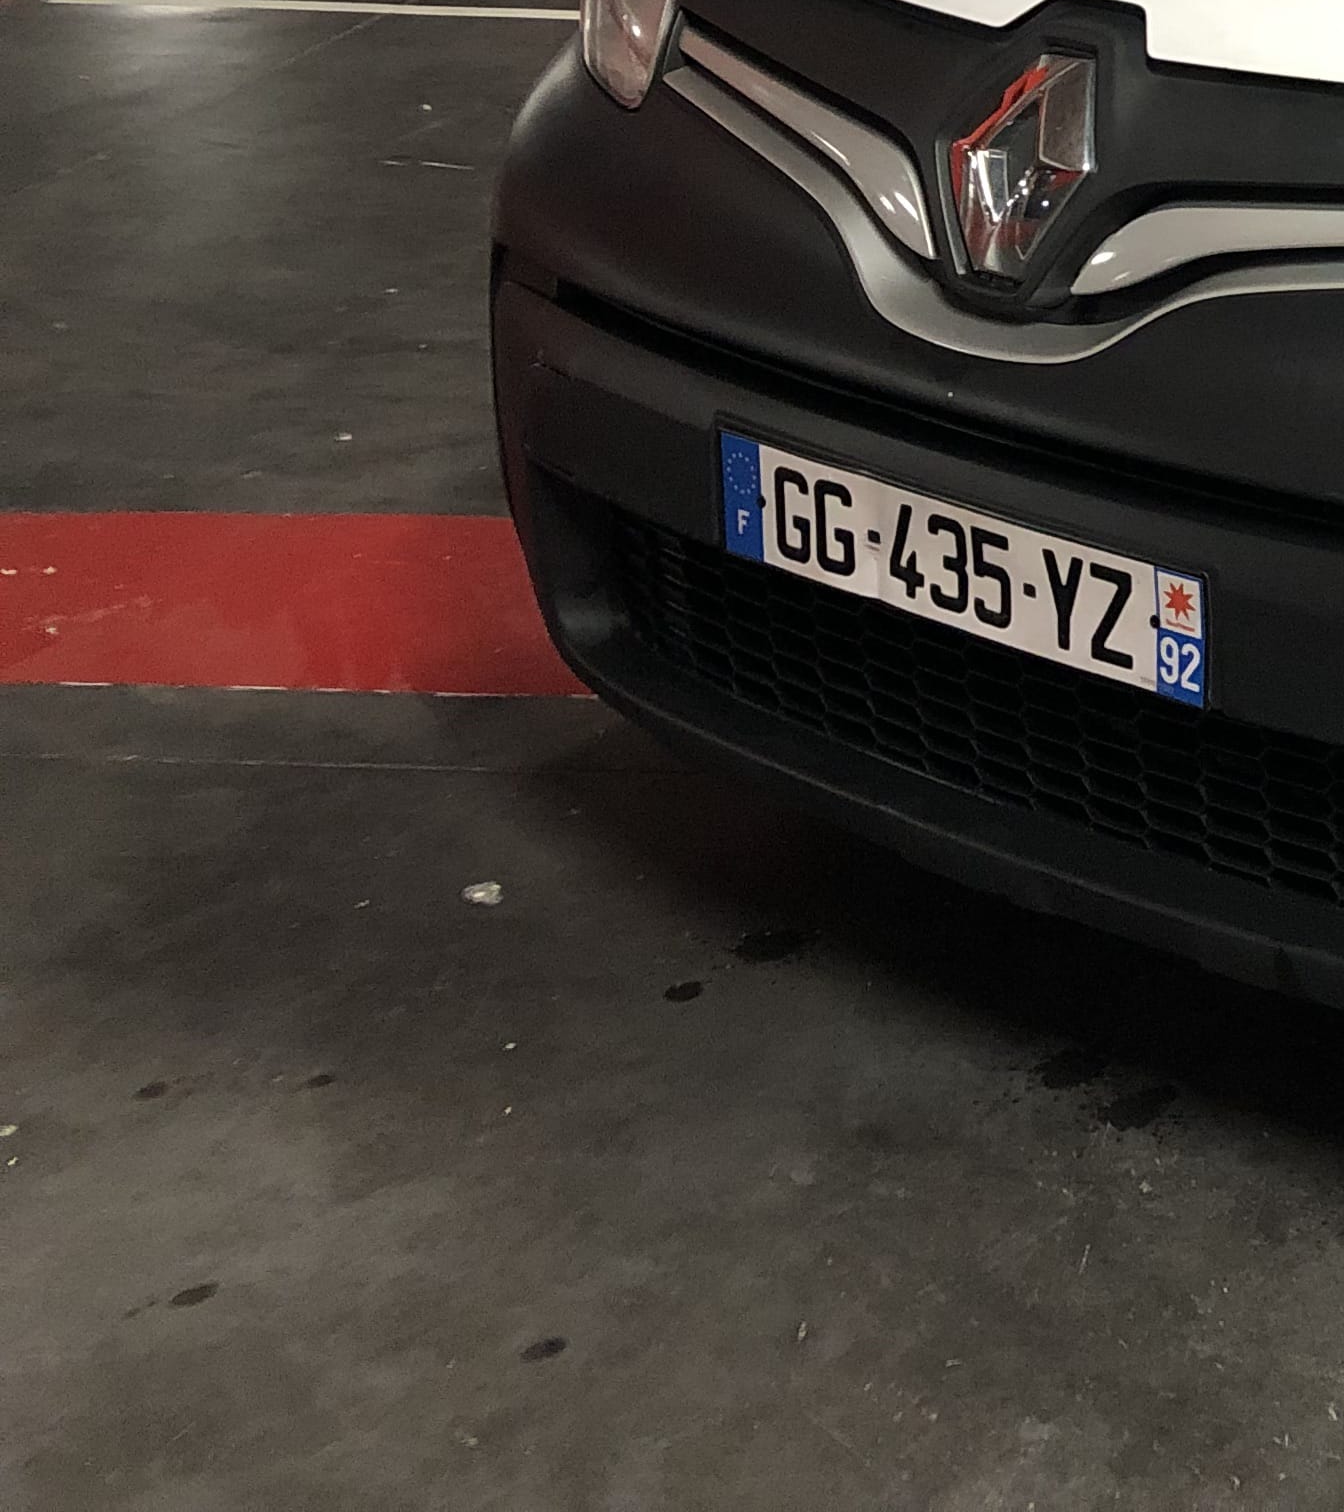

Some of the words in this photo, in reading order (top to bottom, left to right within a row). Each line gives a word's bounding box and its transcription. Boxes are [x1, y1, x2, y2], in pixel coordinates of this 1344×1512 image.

[737, 508, 750, 535] F
[774, 466, 1134, 670] GG-435-YZ
[1160, 636, 1200, 692] 92
